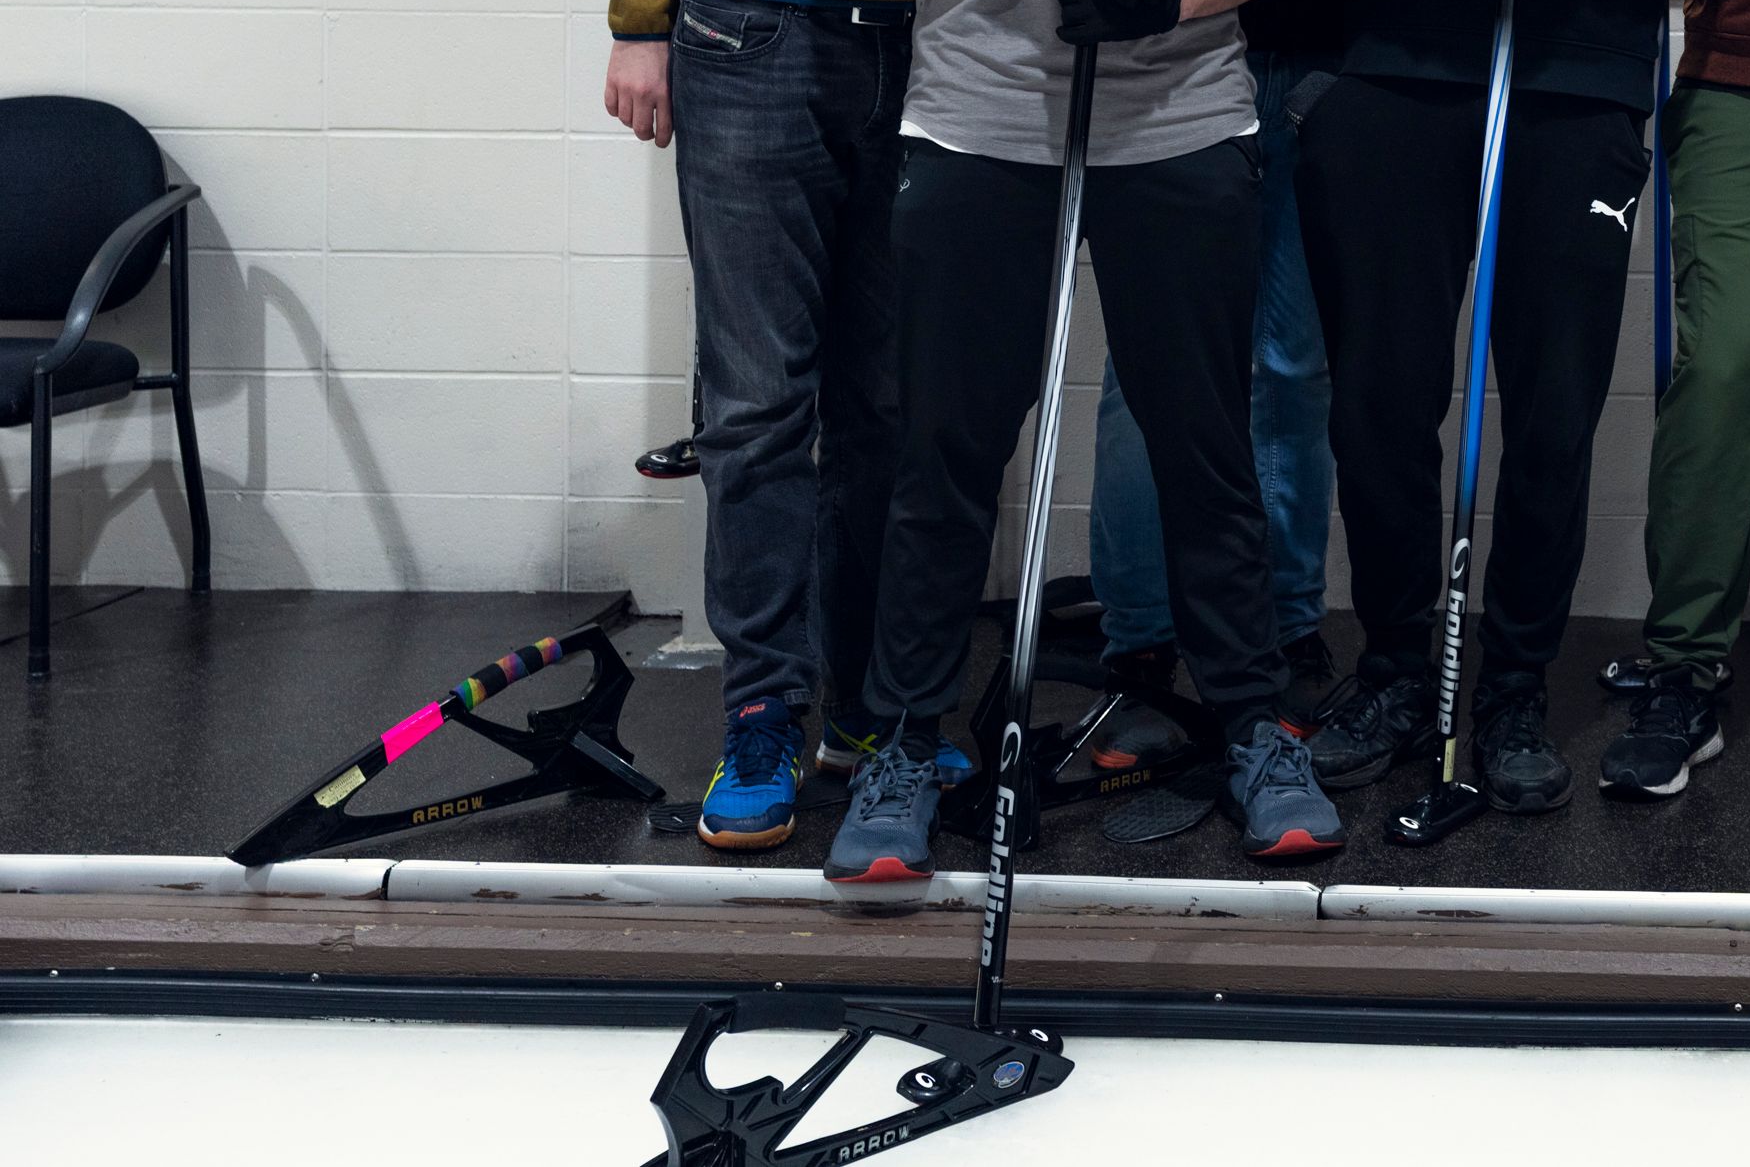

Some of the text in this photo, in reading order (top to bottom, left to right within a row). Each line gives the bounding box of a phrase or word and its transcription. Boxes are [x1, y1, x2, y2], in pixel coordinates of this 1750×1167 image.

[1438, 588, 1467, 735] Goldline
[1100, 770, 1151, 793] ARROW
[412, 795, 483, 825] ARROW
[838, 1124, 911, 1163] ARROW
